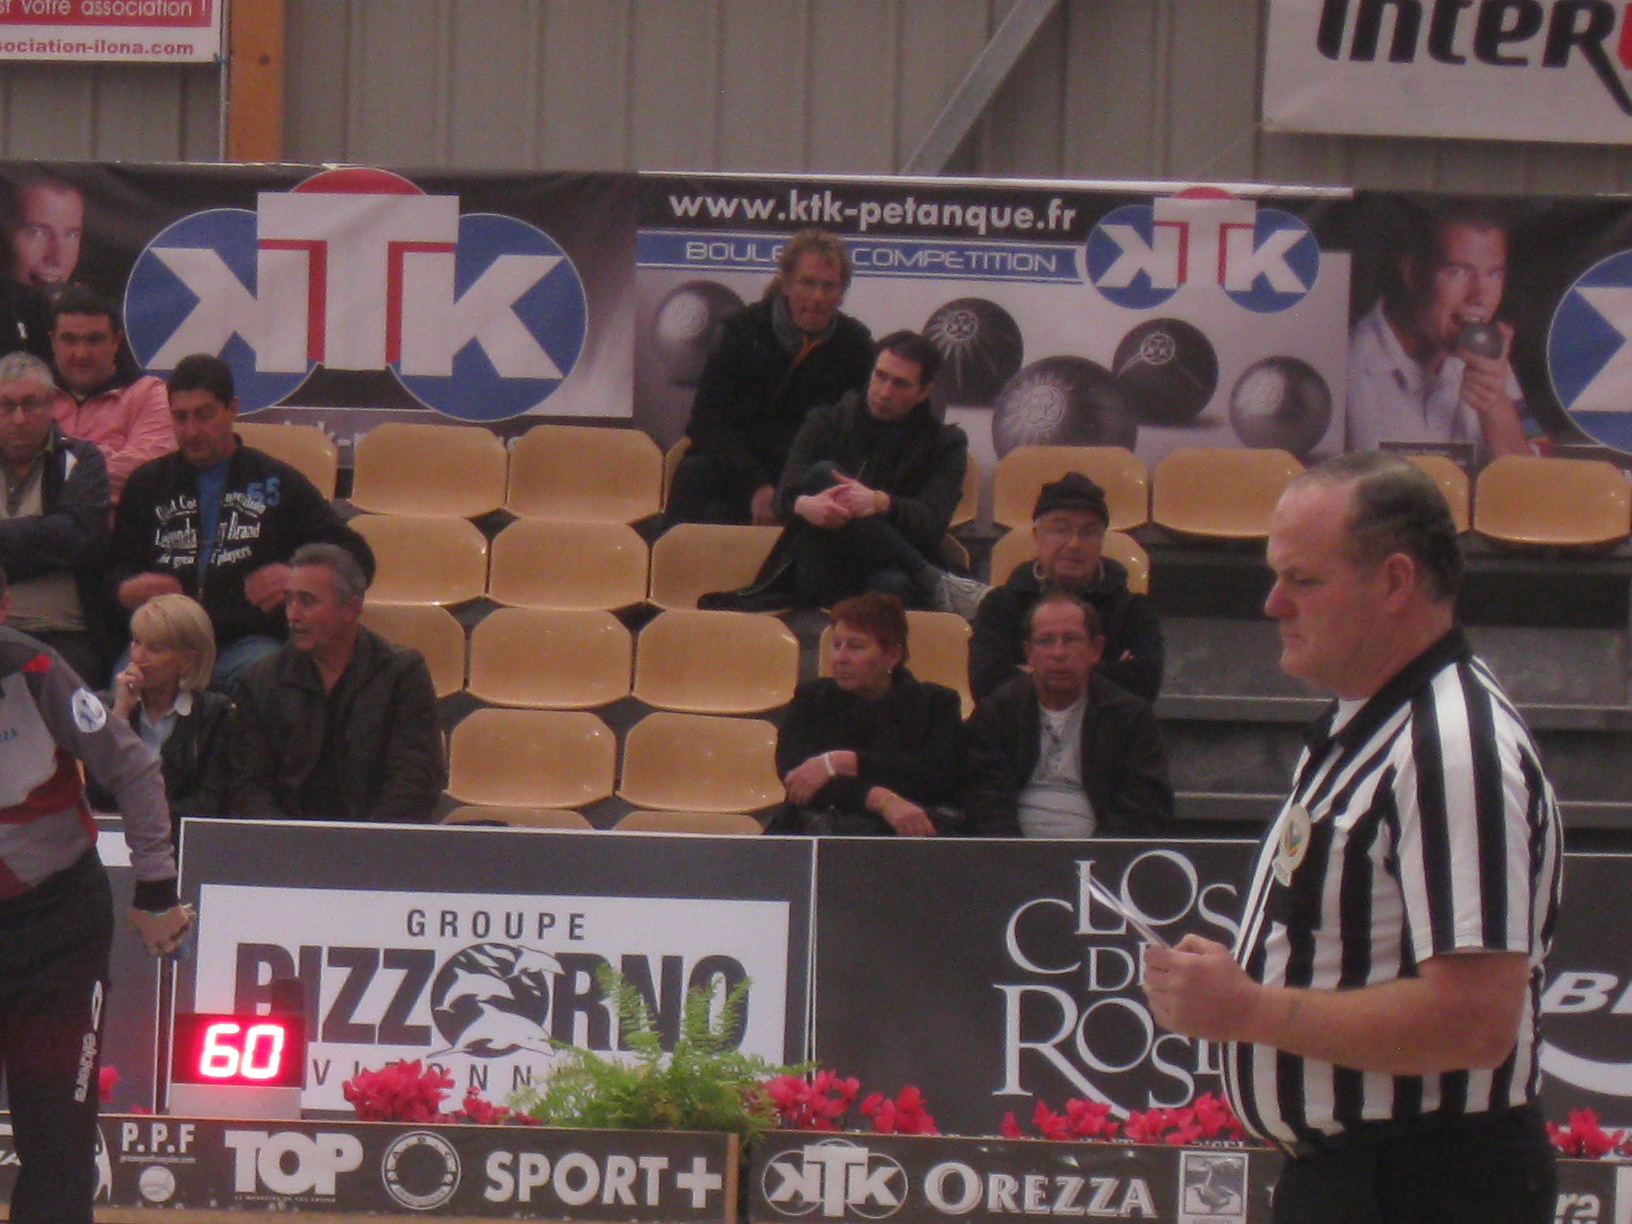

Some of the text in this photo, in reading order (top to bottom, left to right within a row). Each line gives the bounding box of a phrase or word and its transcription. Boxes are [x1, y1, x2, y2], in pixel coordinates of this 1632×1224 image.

[81, 0, 193, 17] association
[669, 189, 1076, 235] www.ktk-petanque.fr
[685, 241, 1058, 273] BOULE COMPETITION
[405, 907, 586, 941] GROUPE
[200, 1024, 285, 1078] 60
[224, 1130, 365, 1196] TOP
[484, 1151, 669, 1207] SPORT
[924, 1161, 1159, 1220] OREZZA
